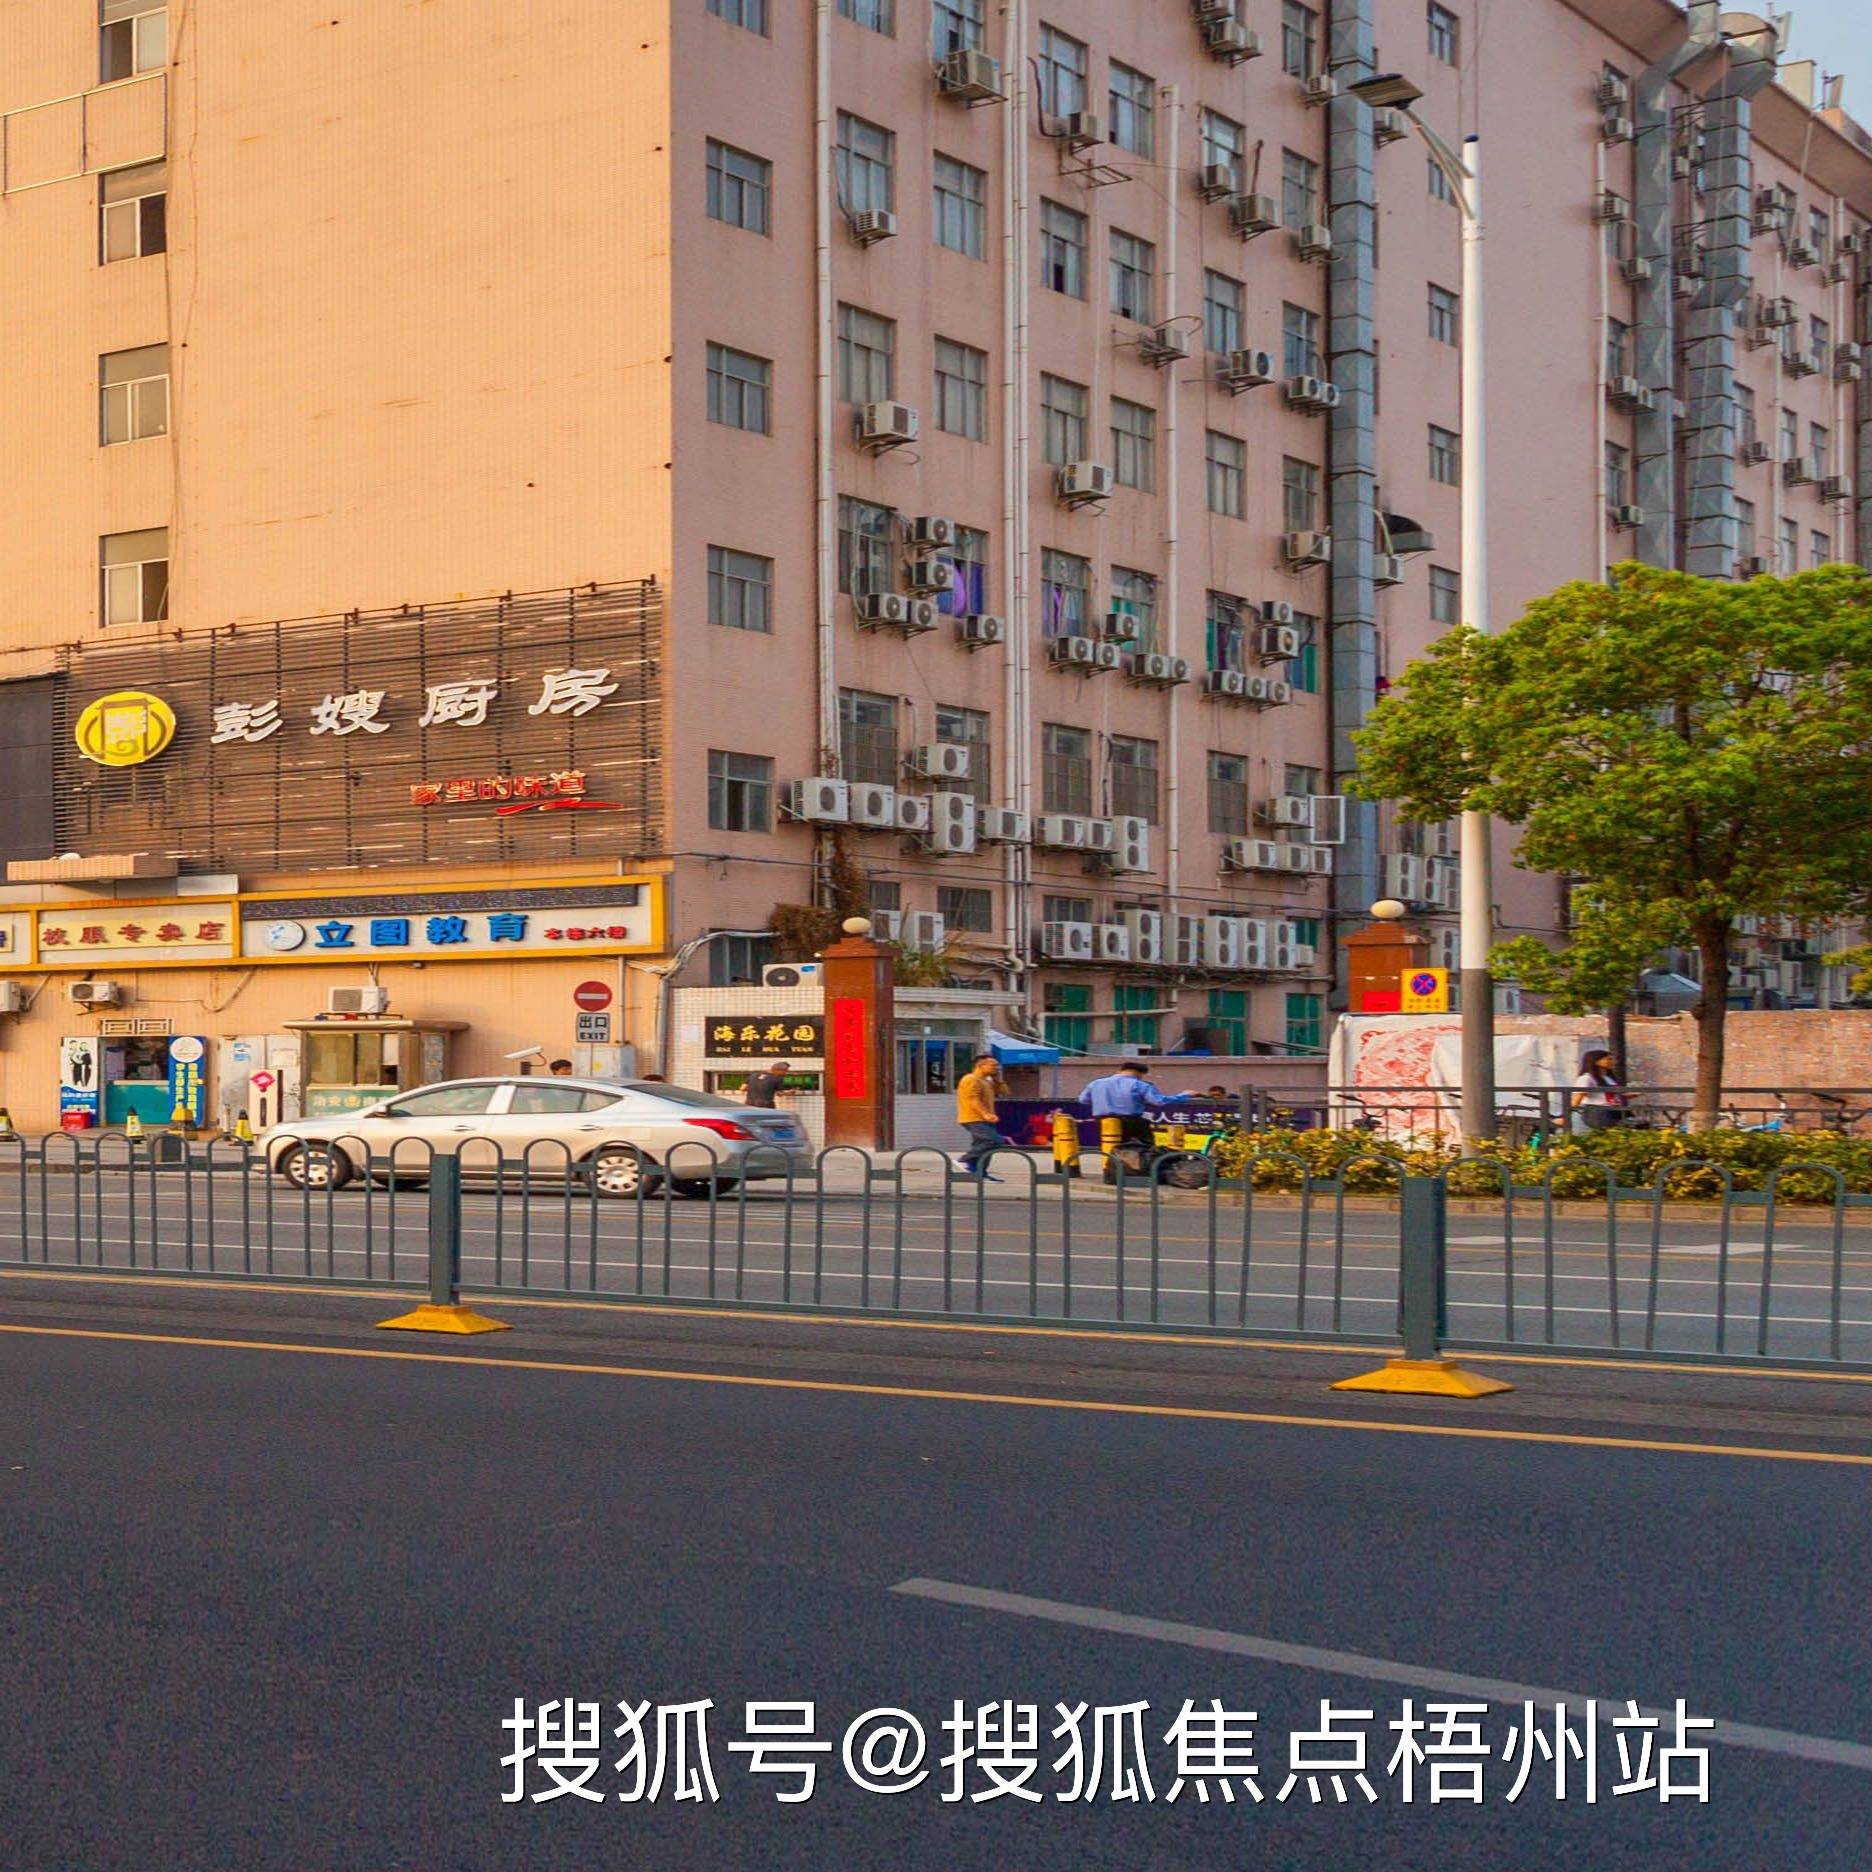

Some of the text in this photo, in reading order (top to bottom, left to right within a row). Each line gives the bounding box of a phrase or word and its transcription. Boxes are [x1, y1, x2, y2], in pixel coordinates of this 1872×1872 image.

[210, 668, 620, 745] 彭嫂厨房
[409, 769, 588, 807] 家里的味道
[42, 920, 226, 947] 校服专卖店
[579, 1015, 607, 1028] 出口
[713, 1023, 816, 1042] 海乐花园
[579, 1032, 606, 1040] EXIT
